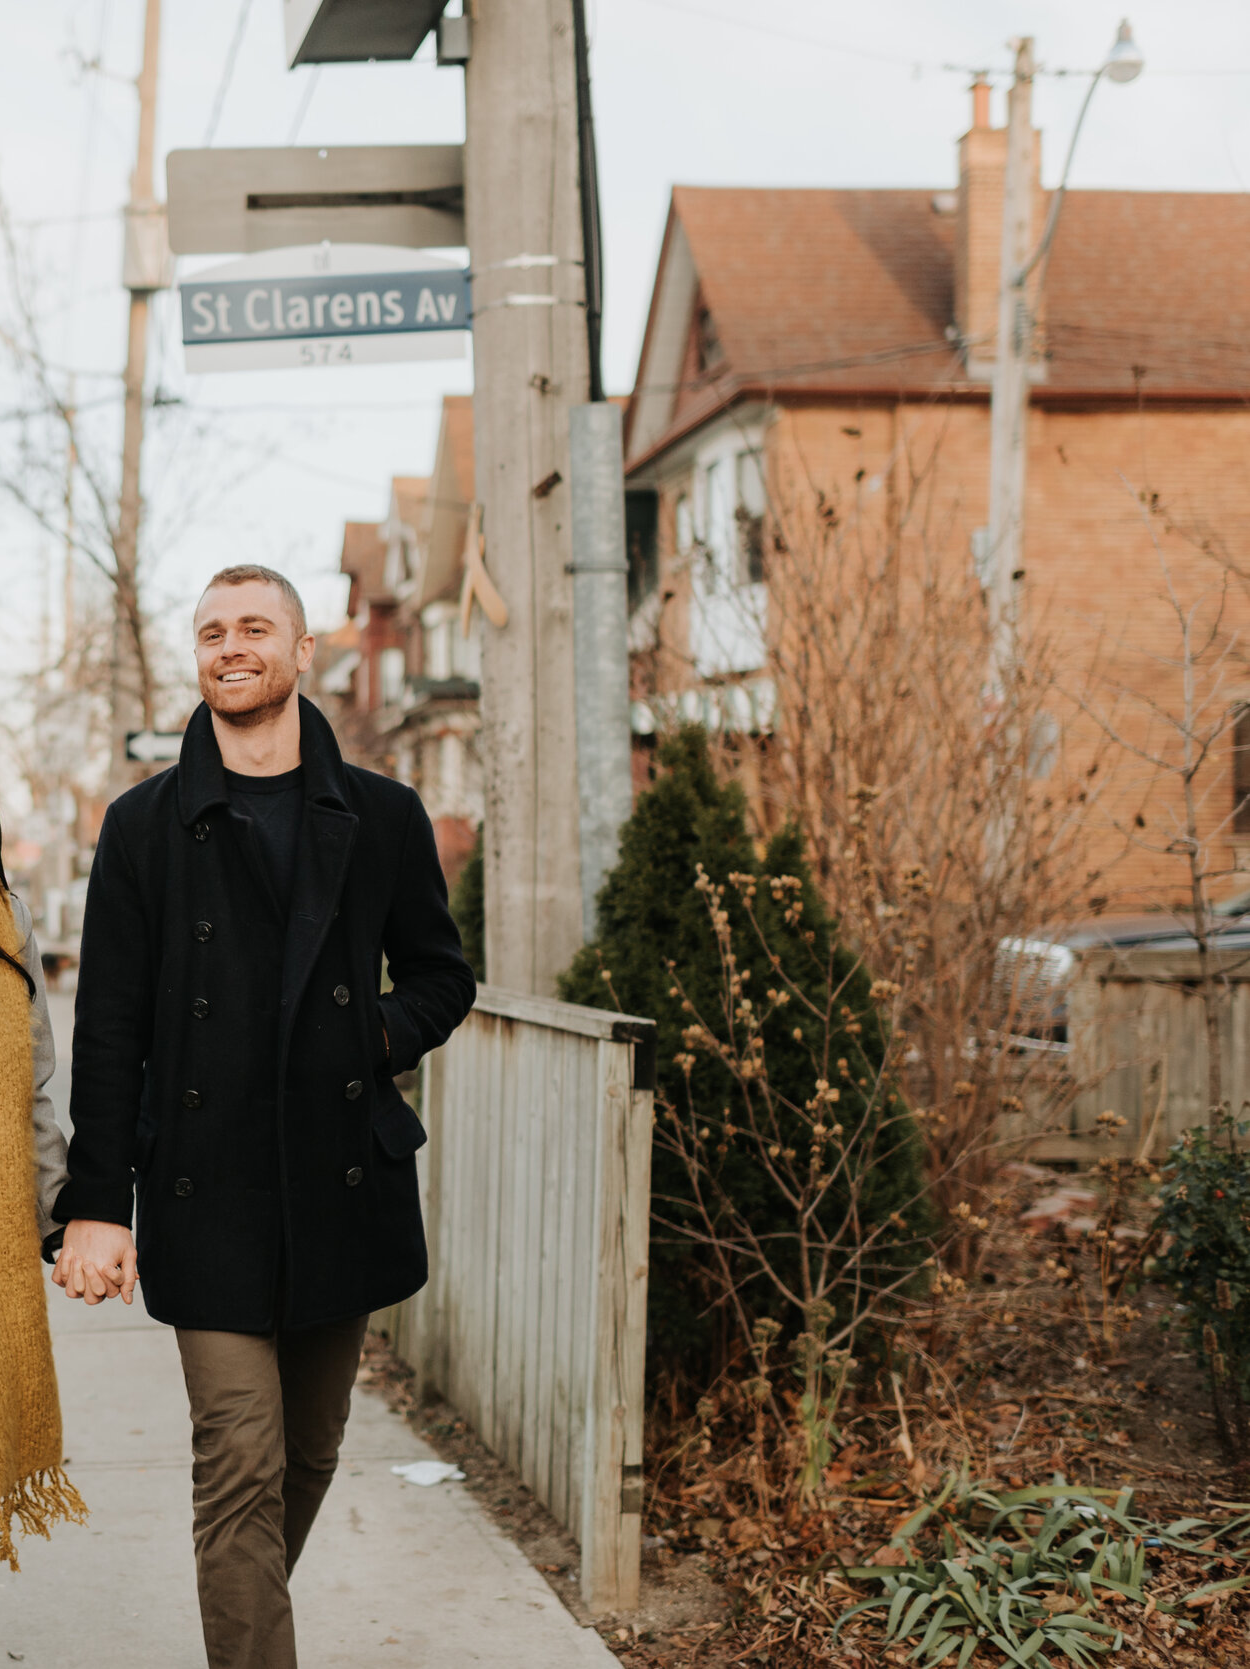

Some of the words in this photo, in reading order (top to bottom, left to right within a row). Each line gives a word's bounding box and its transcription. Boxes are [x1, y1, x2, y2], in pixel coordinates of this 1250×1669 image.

[191, 291, 232, 335] St
[244, 288, 405, 332] Clarens
[416, 288, 457, 323] Av
[300, 343, 352, 365] 574
